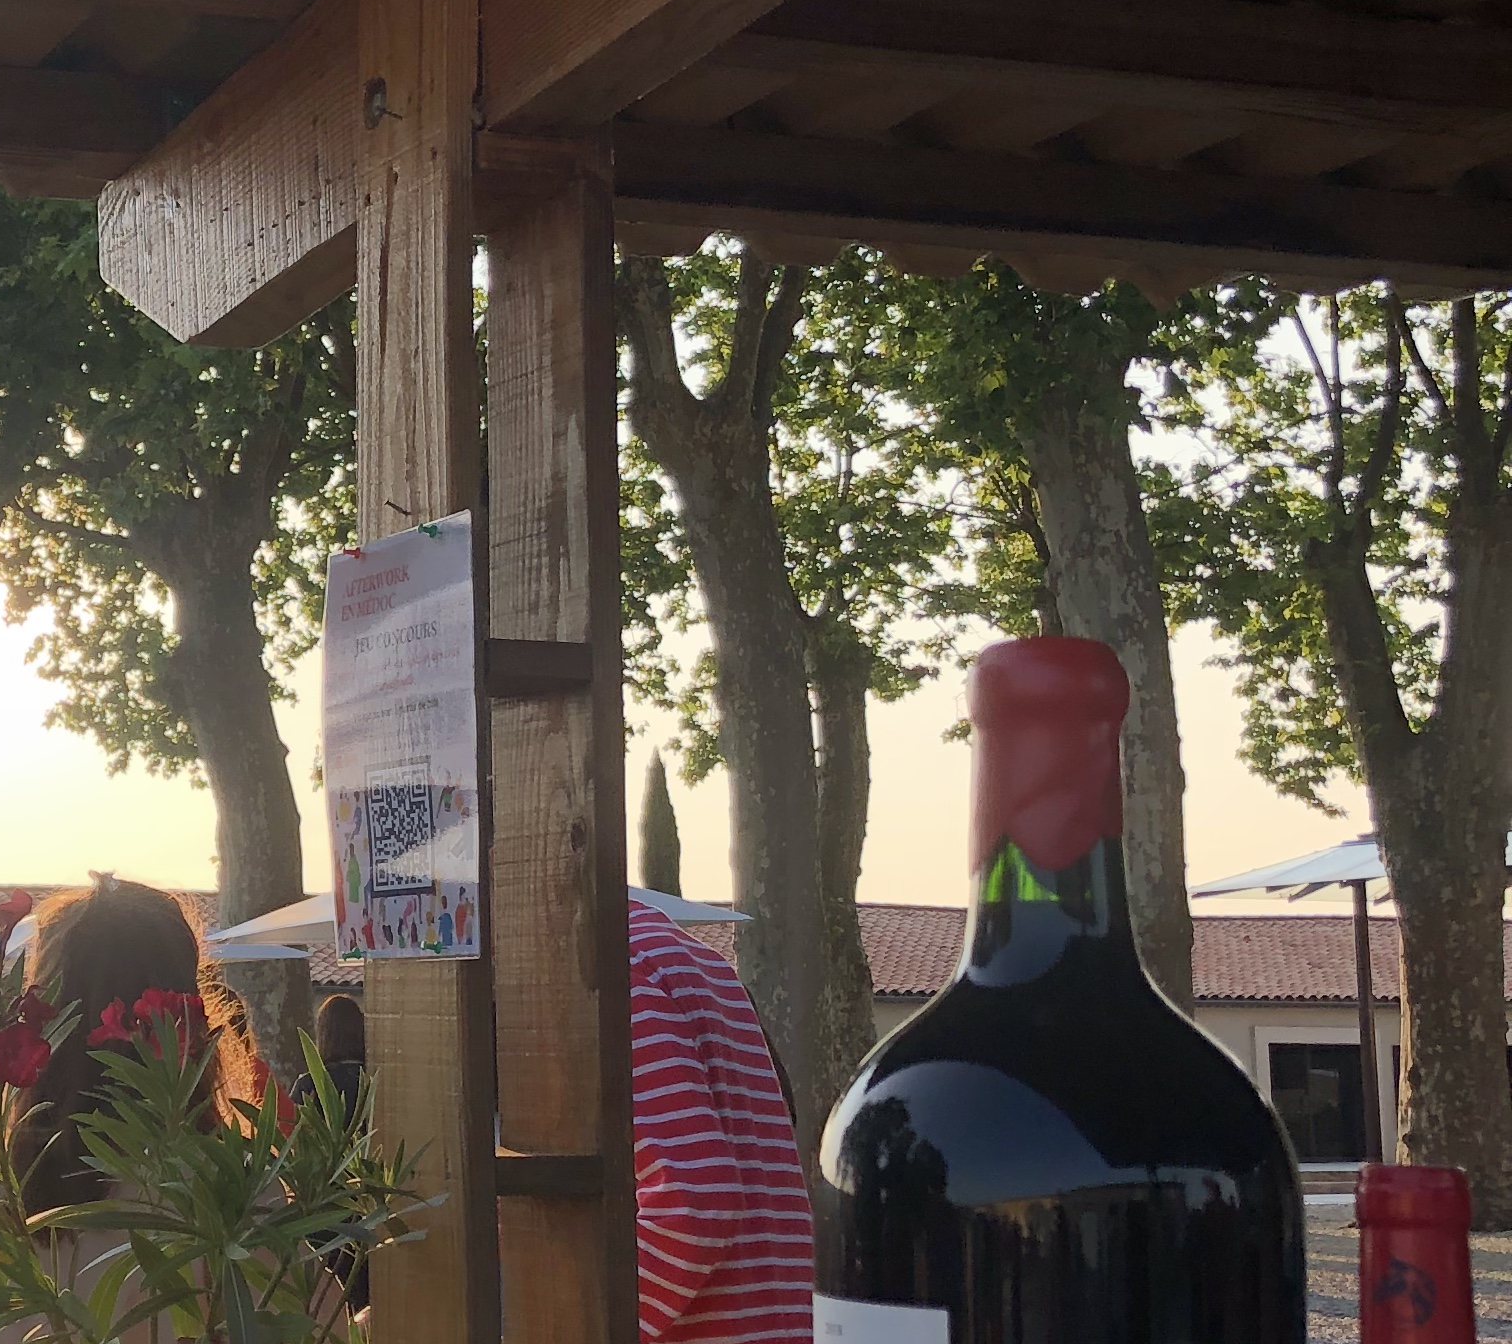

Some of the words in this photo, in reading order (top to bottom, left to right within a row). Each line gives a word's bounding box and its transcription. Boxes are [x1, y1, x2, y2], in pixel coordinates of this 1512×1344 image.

[342, 564, 410, 599] AFTERWORK
[341, 601, 355, 622] EN
[354, 634, 373, 657] JEU
[376, 620, 437, 650] CONCOURS
